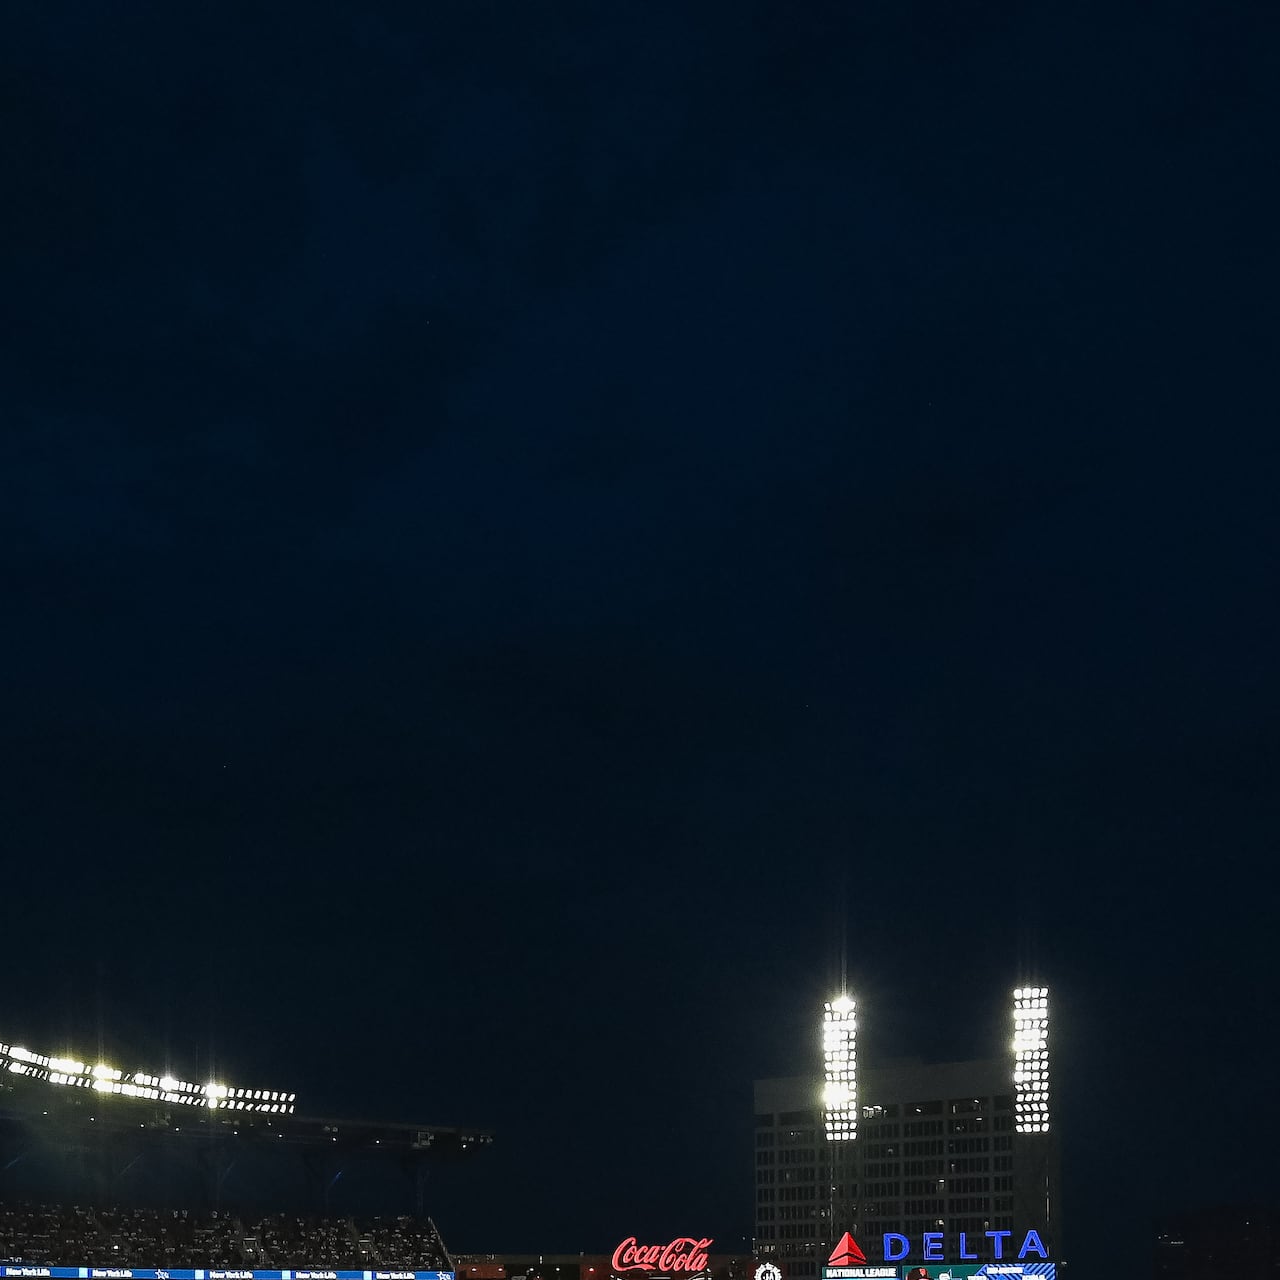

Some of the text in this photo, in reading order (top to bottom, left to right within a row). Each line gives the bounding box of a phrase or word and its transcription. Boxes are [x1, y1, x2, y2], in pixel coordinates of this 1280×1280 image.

[612, 1237, 713, 1273] Coca-Cola
[883, 1230, 1048, 1261] DELTA
[826, 1268, 896, 1278] NATIONAL LEAGUE
